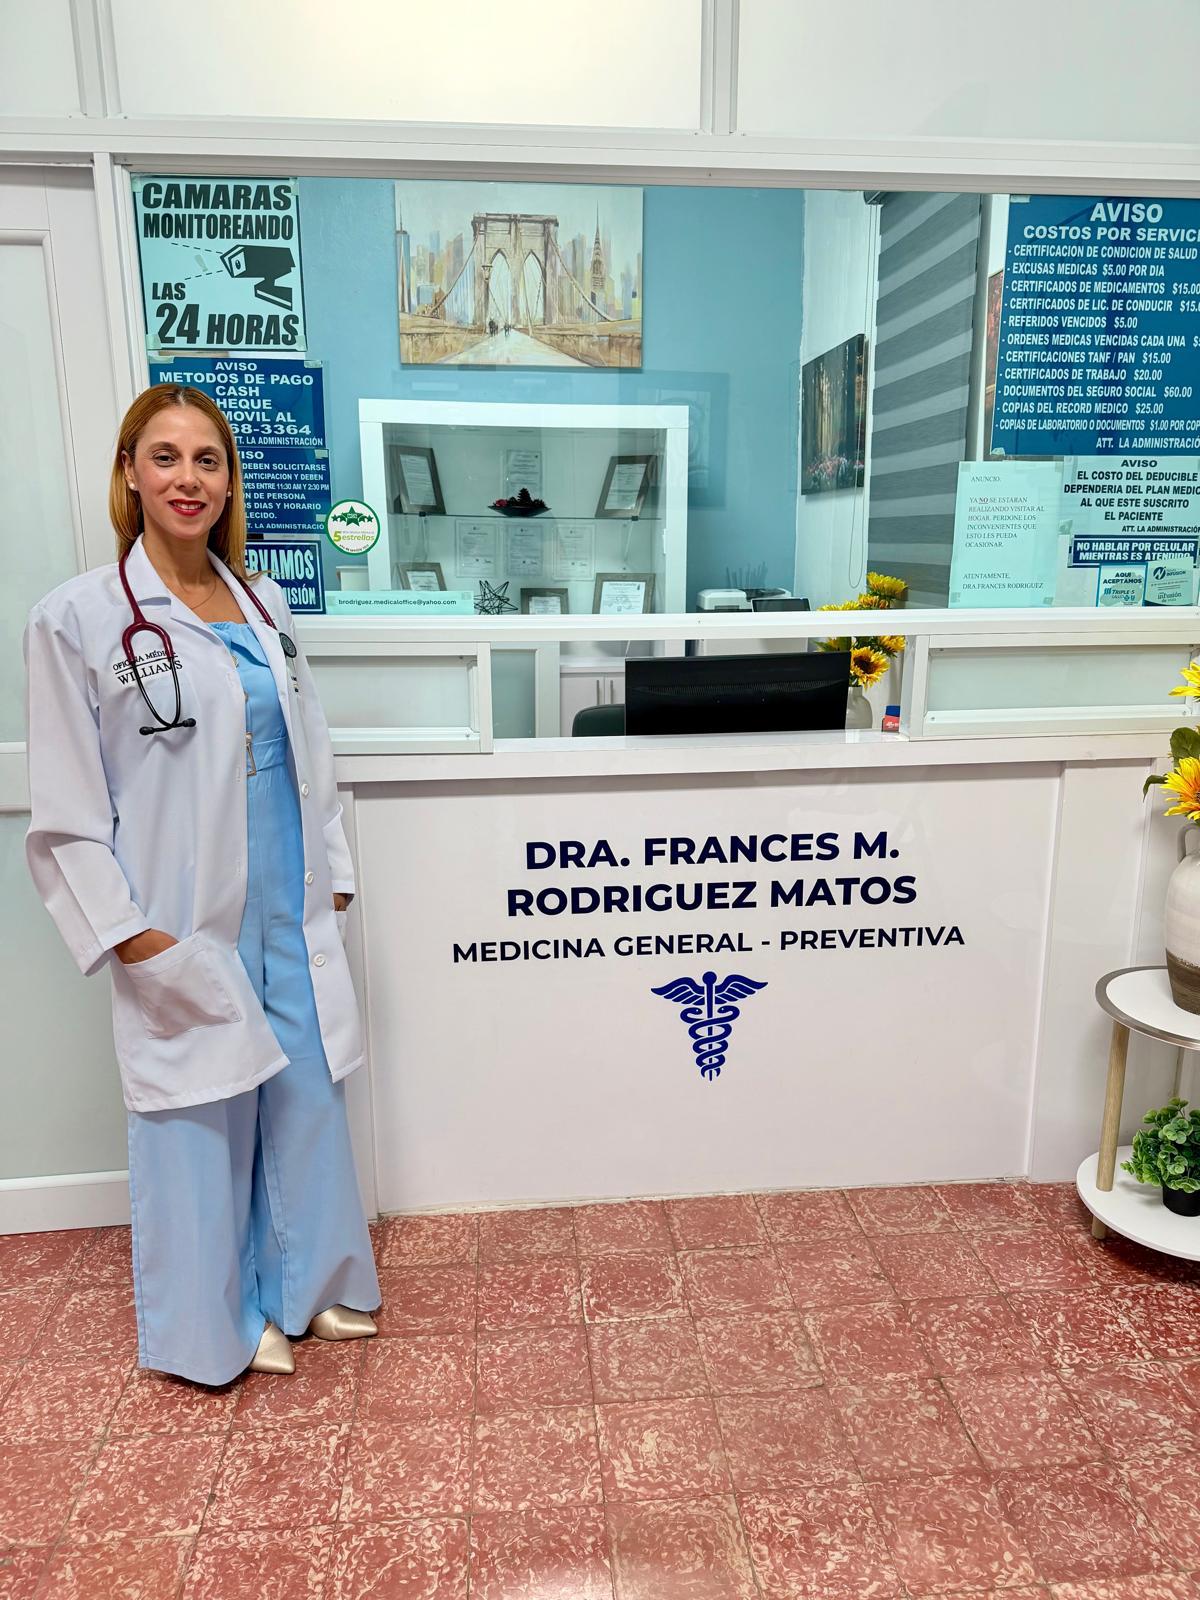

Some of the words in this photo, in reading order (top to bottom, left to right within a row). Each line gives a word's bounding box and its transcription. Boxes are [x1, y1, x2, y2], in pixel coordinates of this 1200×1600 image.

[142, 182, 292, 211] CAMARAS
[1090, 202, 1163, 223] AVISO
[143, 213, 294, 241] MONITOREANDO
[1023, 225, 1092, 240] COSTOS
[1097, 227, 1131, 241] POR
[1013, 245, 1084, 257] CERTIFICACION
[1086, 246, 1099, 258] DE
[1101, 246, 1151, 259] CONDICION
[1154, 247, 1166, 259] DE
[1168, 247, 1198, 260] SALUD
[1012, 262, 1055, 275] EXCUSAS
[1057, 263, 1098, 276] MEDICAS
[1102, 264, 1127, 277] $5.00
[1128, 265, 1148, 277] POR
[1149, 265, 1165, 277] DIA
[151, 282, 186, 301] LAS
[1011, 280, 1077, 293] CERTIFICADOS
[1079, 281, 1092, 293] DE
[1094, 281, 1165, 294] MEDICAMENTOS
[1172, 282, 1200, 295] $15.00
[1010, 298, 1076, 310] CERTIFICADOS
[1078, 299, 1090, 311] DE
[1092, 299, 1109, 311] LIC.
[1111, 300, 1124, 311] DE
[1125, 300, 1173, 312] CONDUCIR
[155, 302, 200, 345] 24
[206, 313, 300, 346] HORAS
[1008, 315, 1059, 327] REFERIDOS
[1061, 316, 1107, 328] VENCIDOS
[1113, 317, 1138, 329] $5.00
[1007, 333, 1050, 346] ORDENES
[1051, 334, 1092, 346] MEDICAS
[1094, 335, 1139, 347] VENCIDAS
[1140, 335, 1165, 347] CADA
[1167, 335, 1186, 347] UNA
[1006, 351, 1086, 363] CERTIFICACIONES
[1088, 352, 1111, 363] TANF
[1117, 352, 1136, 364] PAN
[1142, 352, 1172, 364] $15.00
[215, 361, 258, 371] AVISO
[159, 371, 239, 385] METODOS
[244, 373, 266, 385] DE
[270, 374, 314, 386] PAGO
[1004, 368, 1070, 380] CERTIFICADOS
[1071, 369, 1084, 380] DE
[1086, 369, 1127, 381] TRABAJO
[1133, 369, 1163, 381] $20.00
[215, 385, 260, 397] CASH
[1003, 385, 1065, 397] DOCUMENTOS
[1067, 386, 1084, 397] DEL
[1086, 386, 1123, 397] SEGURO
[1124, 386, 1157, 398] SOCIAL
[1163, 386, 1193, 398] $60.00
[212, 398, 272, 410] HEQUE
[1002, 402, 1035, 414] COPIAS
[1037, 402, 1054, 414] DEL
[1056, 402, 1092, 414] RECORD
[1094, 403, 1129, 415] MEDICO
[1135, 403, 1164, 415] $25.00
[222, 410, 271, 422] MOVIL
[275, 412, 296, 423] AL
[1000, 419, 1026, 430] COPIAS
[1027, 419, 1037, 430] DE
[1038, 419, 1088, 430] LABORATORIO
[1089, 420, 1095, 430] O
[1096, 420, 1145, 430] DOCUMENTOS
[1150, 419, 1169, 431] $1.00
[1169, 420, 1185, 431] POR
[246, 437, 256, 445] LA
[258, 436, 323, 446] ADMINISTRACIÓN
[1096, 437, 1115, 449] ATT.
[1118, 438, 1131, 449] LA
[237, 451, 264, 460] ISO
[272, 463, 327, 471] SOLICITARSE
[1121, 459, 1158, 468] AVISO
[1077, 471, 1089, 480] EL
[1091, 471, 1123, 480] COSTO
[1125, 472, 1143, 481] DEL
[1146, 472, 1198, 482] DEDUCIBLE
[1064, 484, 1123, 494] DEPENDERIA
[1125, 485, 1143, 494] DEL
[1145, 485, 1170, 495] PLAN
[1080, 498, 1093, 507] AL
[1095, 498, 1115, 508] QUE
[1117, 498, 1141, 507] ESTE
[1143, 498, 1190, 509] SUSCRITO
[1104, 511, 1116, 520] EL
[1118, 512, 1163, 521] PACIENTE
[266, 522, 325, 530] ADMINISTRACIÓ
[1121, 525, 1135, 533] ATT.
[333, 531, 342, 542] 5
[1076, 542, 1090, 551] NO
[1091, 542, 1130, 551] HABLAR
[1131, 543, 1151, 551] POR
[1153, 543, 1195, 552] CELULAR
[1079, 552, 1129, 560] MIENTRAS
[1130, 552, 1143, 560] ES
[525, 840, 630, 871] DRA.
[644, 831, 840, 867] FRANCES
[853, 831, 900, 860] M.
[507, 880, 758, 917] RODRIGUEZ
[771, 874, 918, 909] MATOS
[452, 937, 606, 964] MEDICINA
[613, 932, 753, 958] GENERAL
[780, 926, 966, 952] PREVENTIVA
